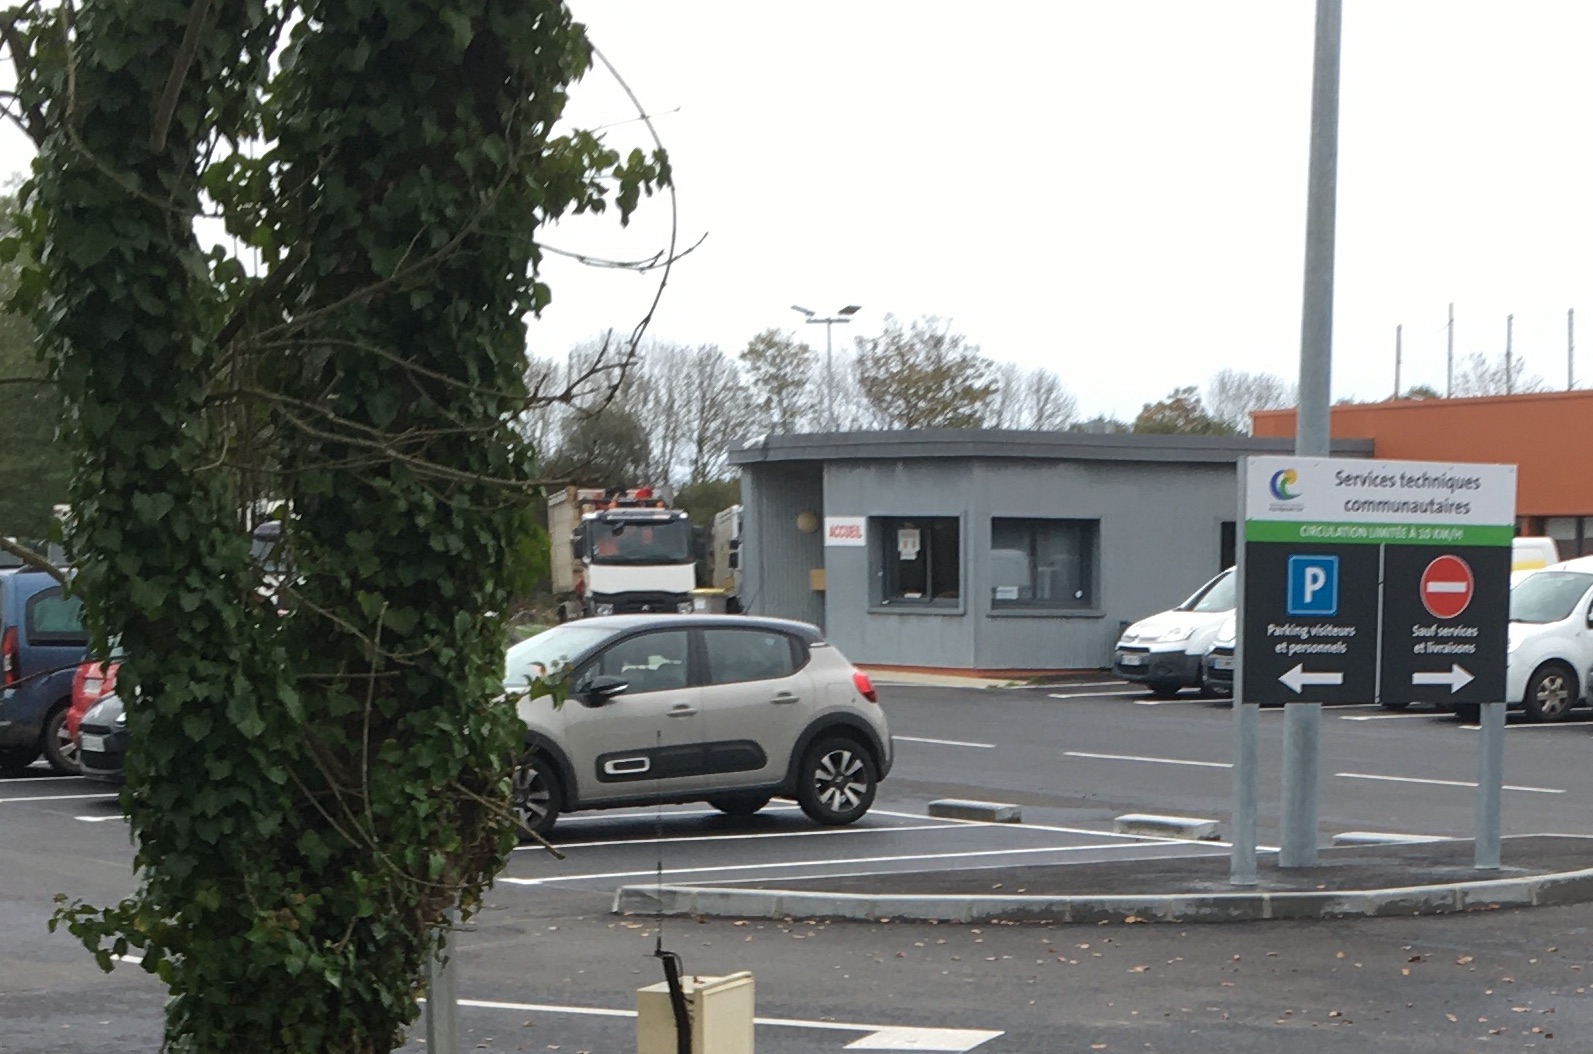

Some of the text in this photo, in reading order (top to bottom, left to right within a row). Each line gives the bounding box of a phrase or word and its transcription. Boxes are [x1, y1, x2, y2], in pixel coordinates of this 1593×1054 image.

[1335, 470, 1481, 494] Services techniques
[1344, 498, 1471, 515] communautaires
[829, 524, 862, 539] ACCUEIL
[1300, 525, 1368, 538] CIRCULATION
[1304, 567, 1326, 604] P
[1267, 623, 1356, 639] Parking visiteurs
[1412, 623, 1479, 636] Sauf services
[1275, 640, 1347, 656] et personnels
[1413, 641, 1476, 653] et livraisons
